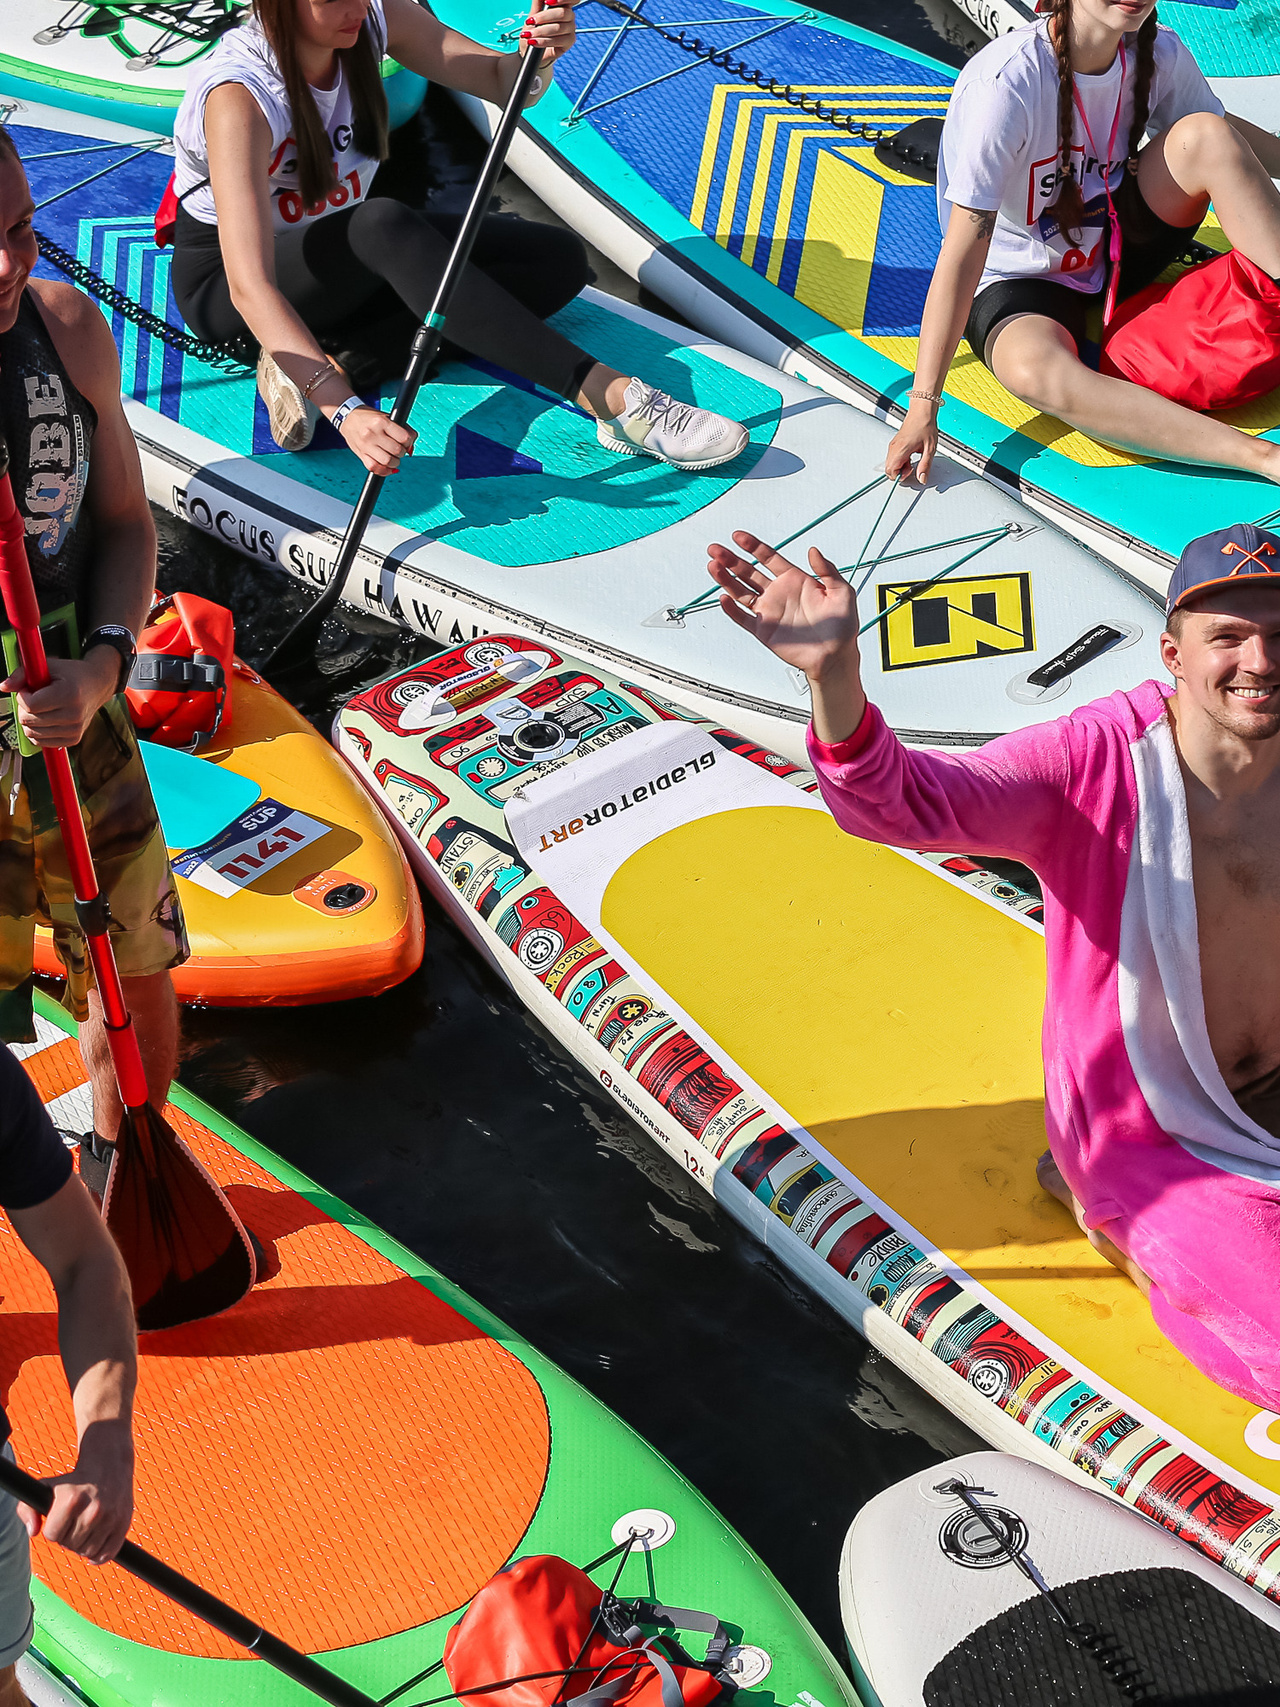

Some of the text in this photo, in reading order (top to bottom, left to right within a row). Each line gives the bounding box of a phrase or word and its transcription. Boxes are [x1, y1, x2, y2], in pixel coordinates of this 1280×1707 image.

[172, 485, 277, 563] FOCUS
[242, 807, 277, 831] SUP
[183, 859, 199, 878] 2022
[217, 826, 306, 879] 1141
